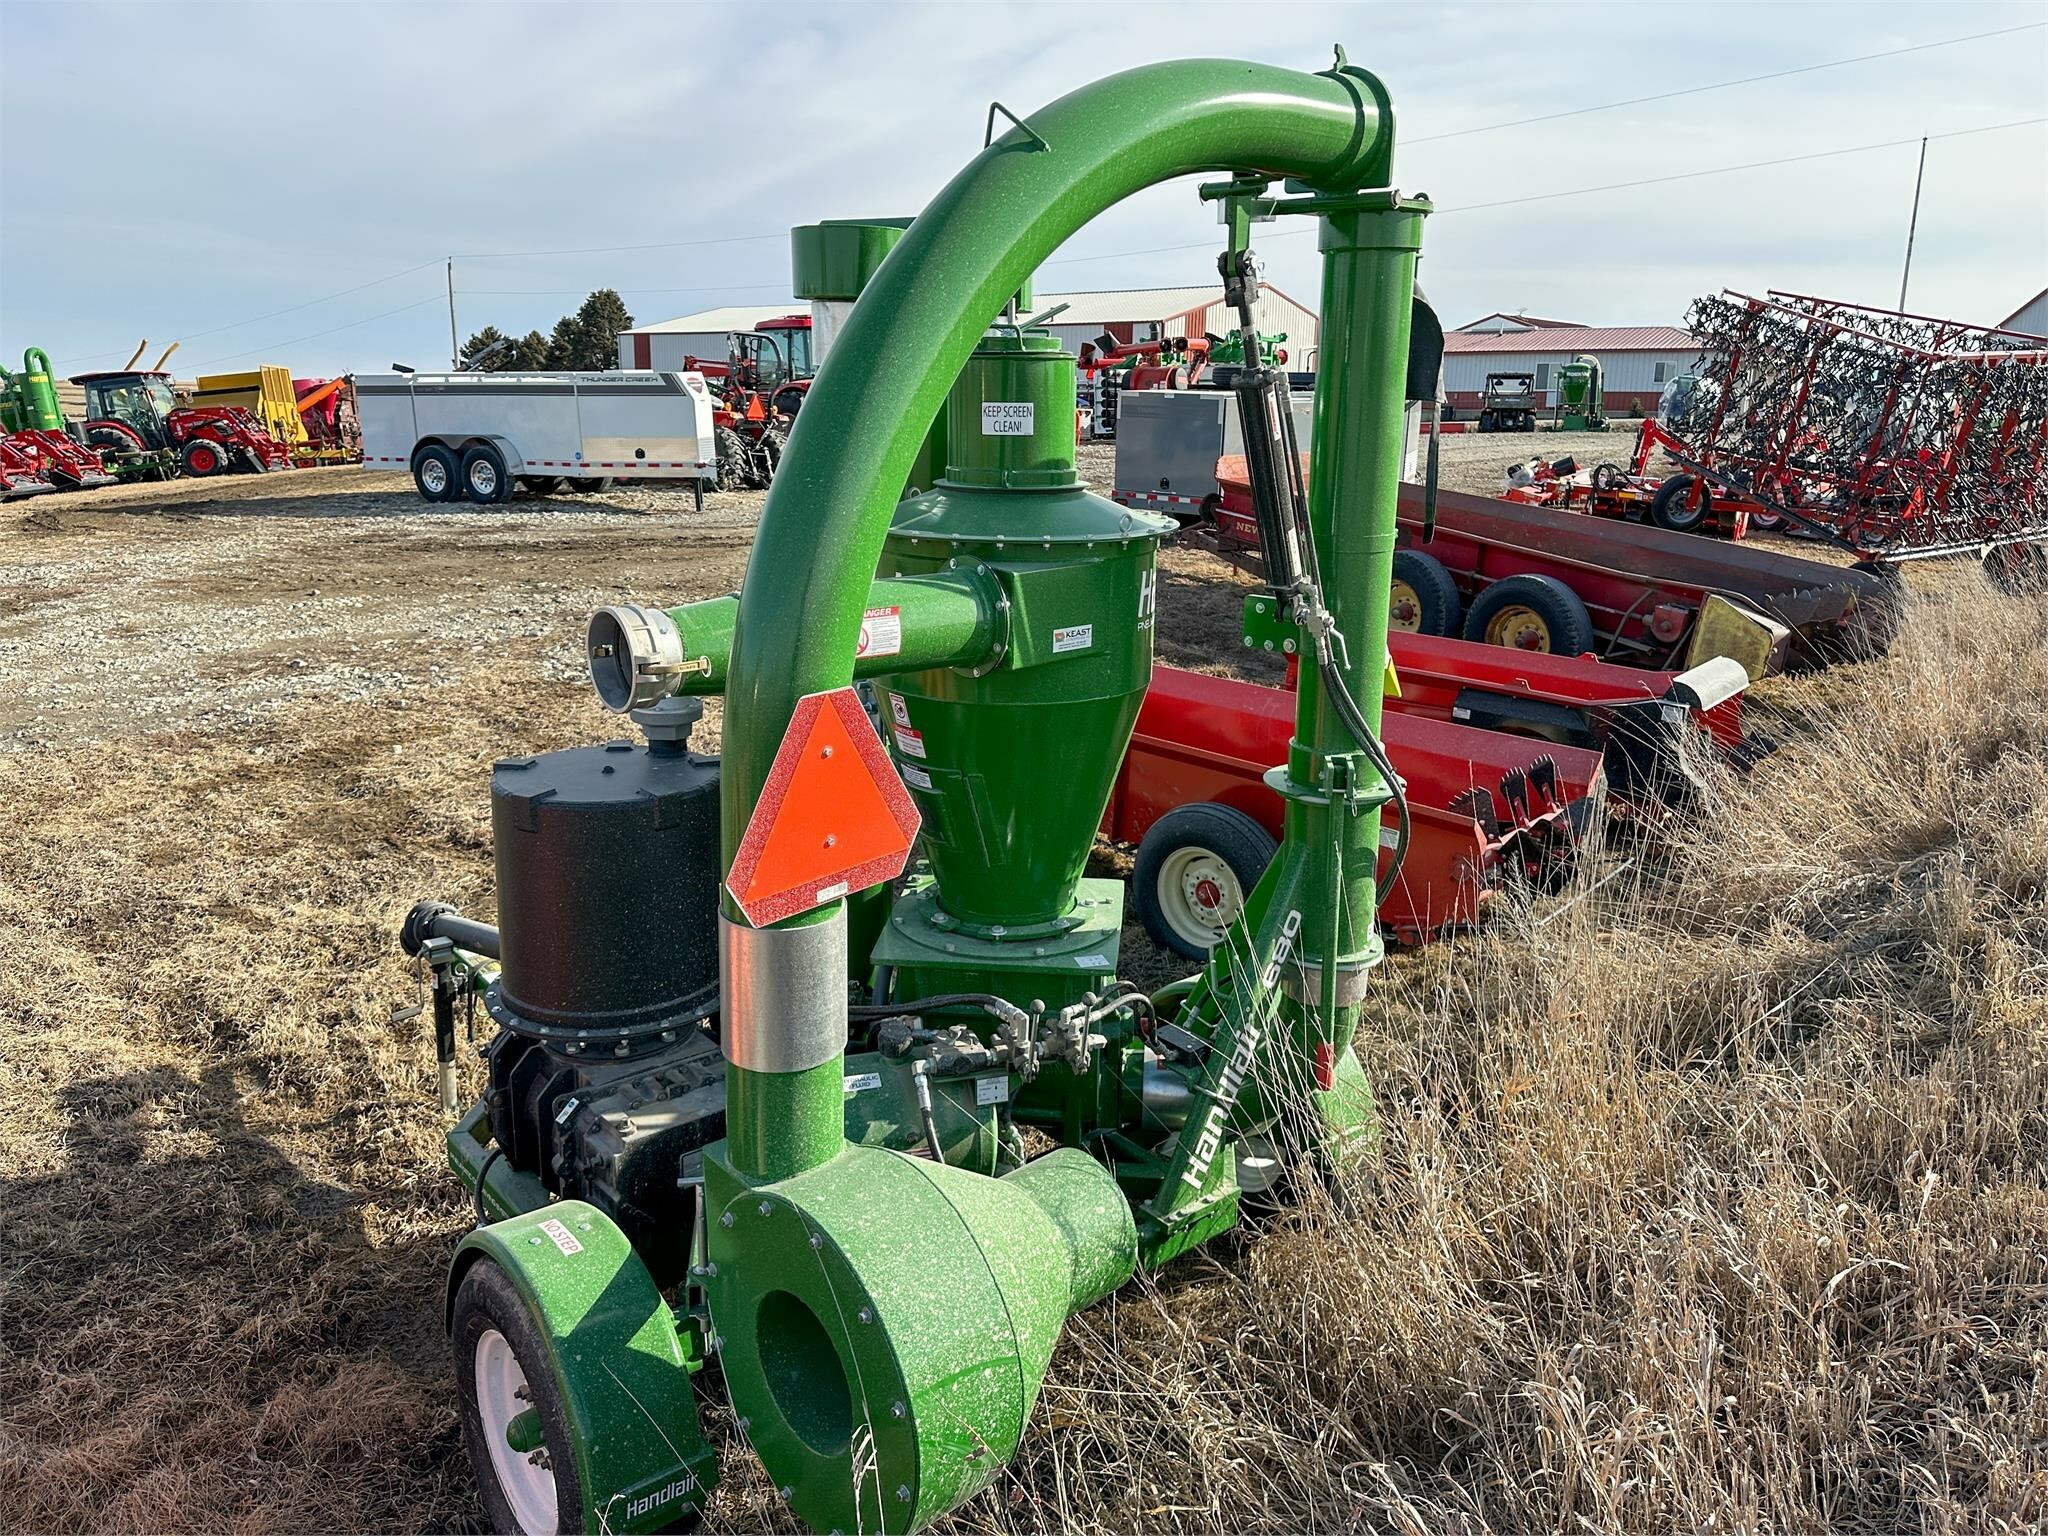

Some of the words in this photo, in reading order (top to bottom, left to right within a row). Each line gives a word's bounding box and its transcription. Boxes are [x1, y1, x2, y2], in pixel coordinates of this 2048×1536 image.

[983, 405, 1002, 418] KEEP
[1003, 405, 1032, 418] SCREEN
[993, 420, 1022, 433] CLEAN!
[1066, 627, 1091, 639] KEAST
[1262, 908, 1302, 990] 680
[543, 1219, 556, 1233] NO
[553, 1230, 580, 1253] STEP
[626, 1474, 699, 1520] Handlair
